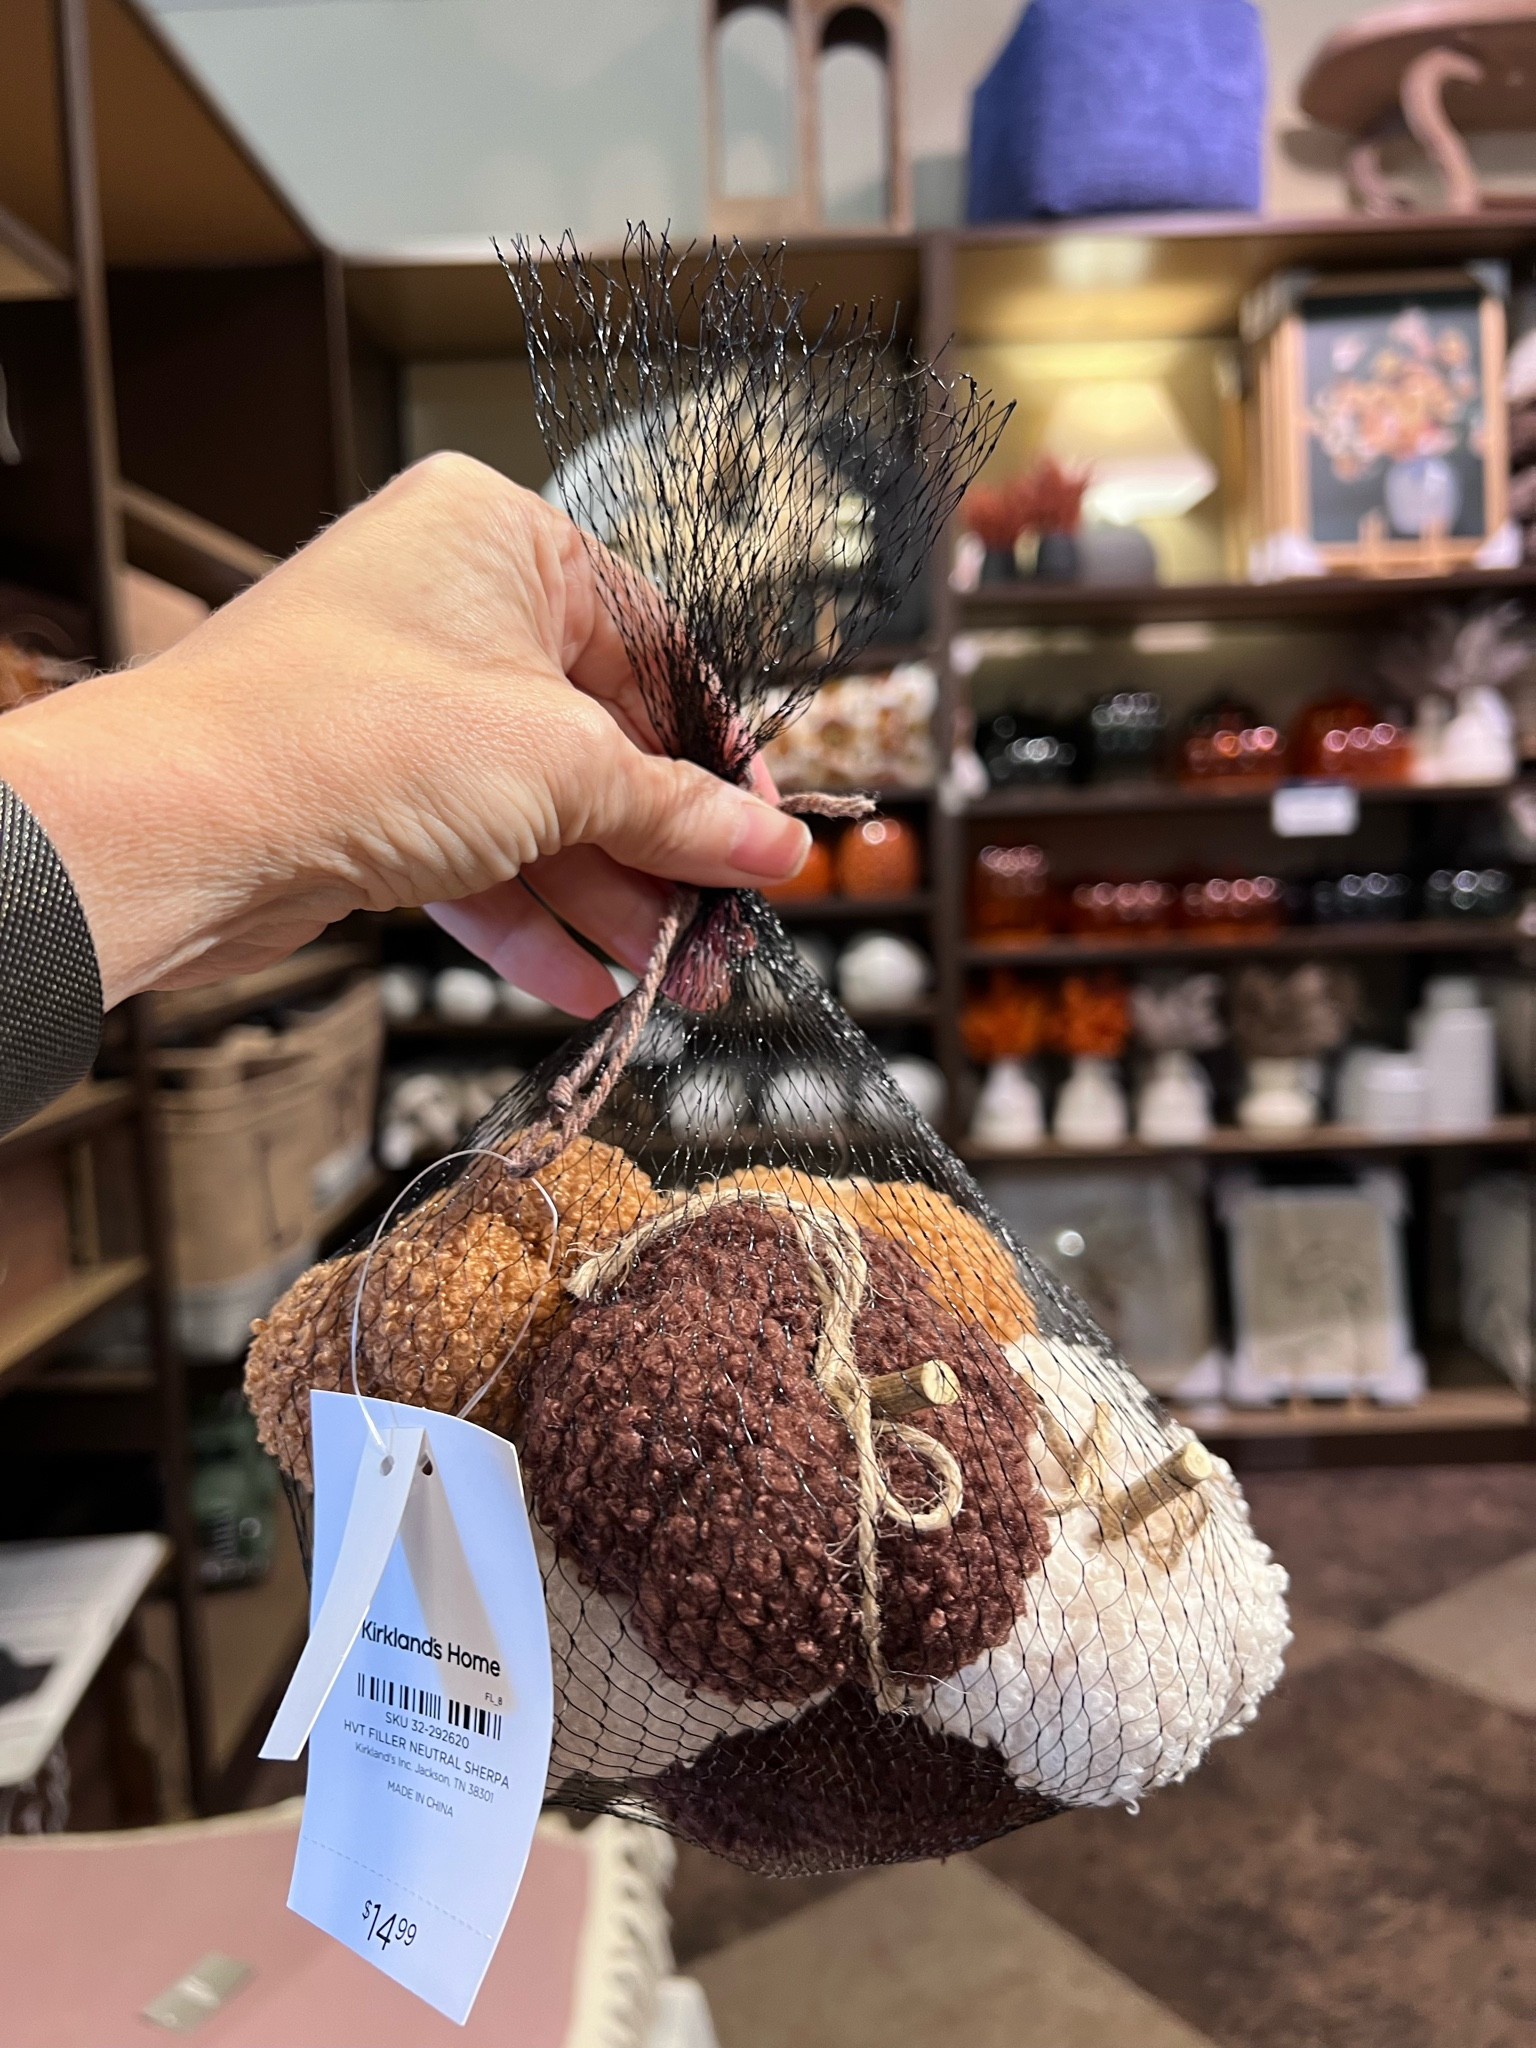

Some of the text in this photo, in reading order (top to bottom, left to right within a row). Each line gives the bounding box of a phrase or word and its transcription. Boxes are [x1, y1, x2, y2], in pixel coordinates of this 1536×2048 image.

[361, 1619, 501, 1677] Kirkland's Home
[344, 1719, 510, 1789] HVT FILLER NEUTRAL SHERPA
[385, 1711, 470, 1749] SKU 32-292620
[355, 1741, 396, 1765] Kirkland's
[454, 1777, 467, 1792] TN
[467, 1783, 494, 1803] 38301
[387, 1780, 454, 1817] MADE IN CHINA
